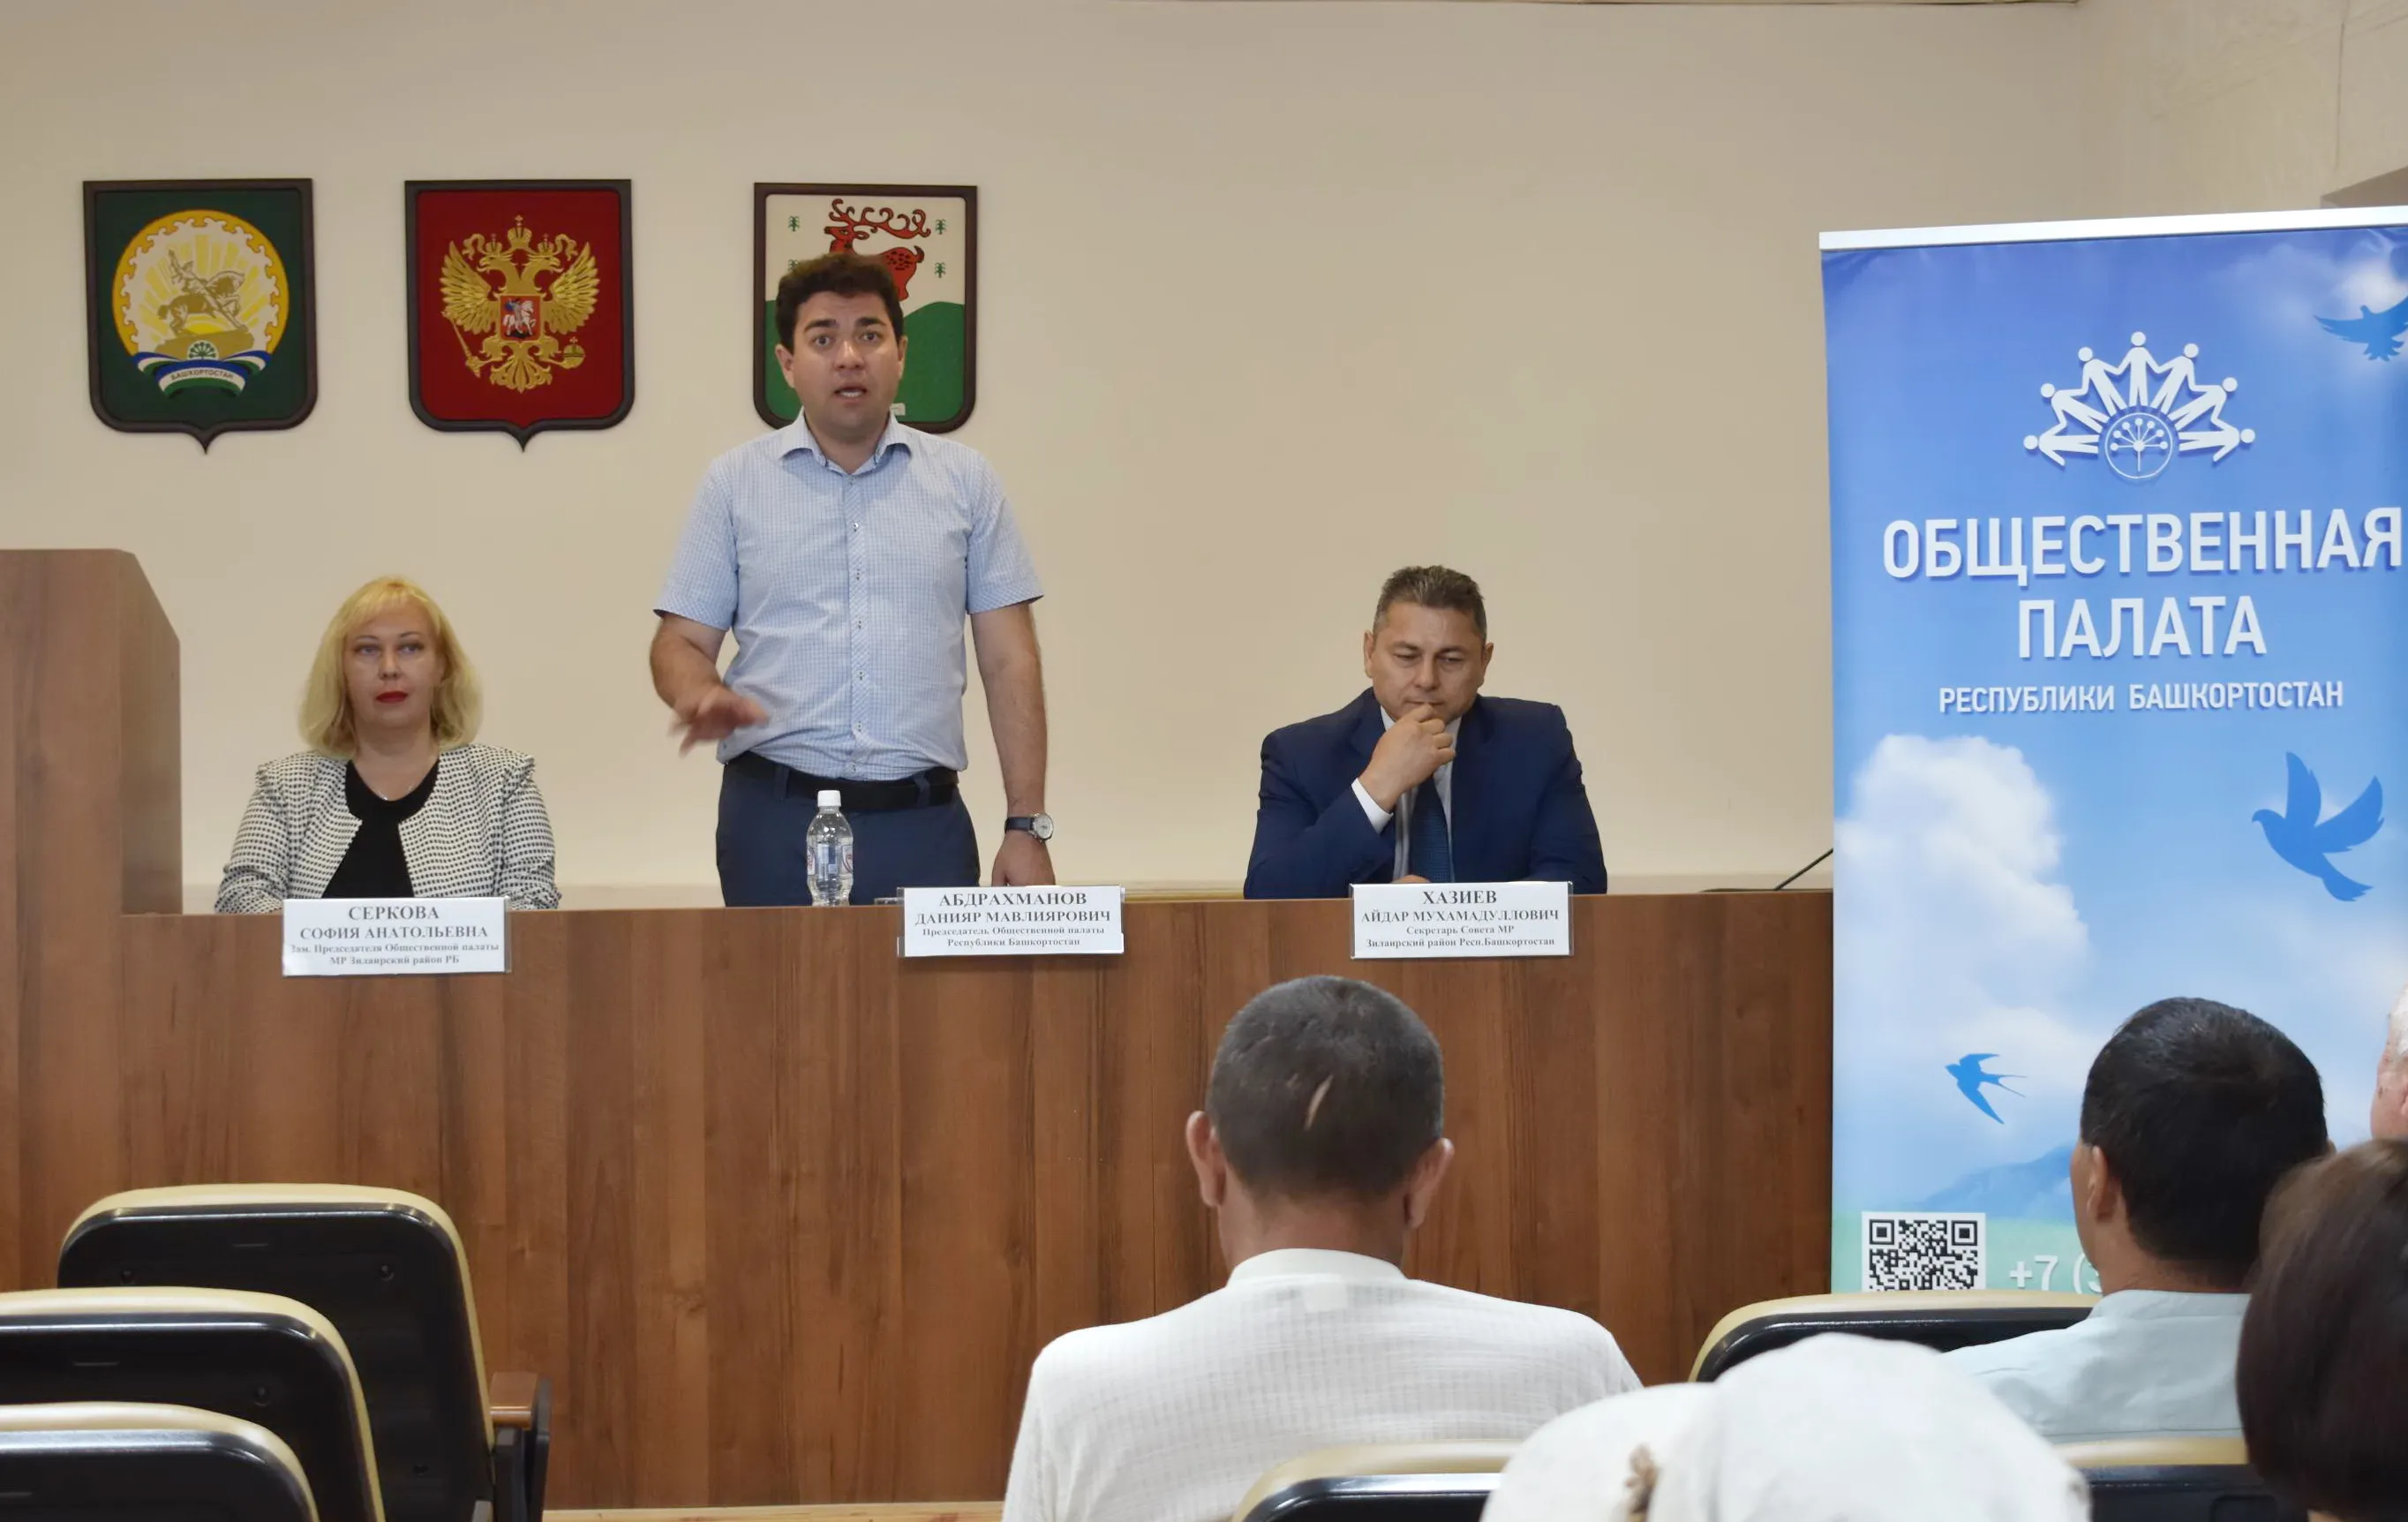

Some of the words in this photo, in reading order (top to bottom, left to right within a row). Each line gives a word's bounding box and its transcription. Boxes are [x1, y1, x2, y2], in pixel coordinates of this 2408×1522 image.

[171, 369, 234, 380] БАШКОРТОСТАН
[1883, 507, 2403, 587] ОБЩЕСТВЕННАЯ
[2018, 595, 2268, 659] ПАЛАТА
[1938, 685, 2115, 713] РЕСПУБЛИКИ
[2129, 681, 2344, 710] БАШКОРТОСТАН
[939, 893, 1087, 907] АБДРАХМАНОВ
[1422, 890, 1498, 905] ХАЗИЕВ
[349, 906, 440, 920] СЕРКОВА
[914, 912, 982, 925] ДАНИЯР
[986, 910, 1110, 923] МАВЛИЯРОВИЧ
[1361, 909, 1409, 923] АЙДАР
[1413, 909, 1560, 922] МУХАМАДУЛЛОВИЧ
[300, 927, 360, 939] СОФИЯ
[365, 925, 488, 938] АНАТОЛЬЕВНА
[922, 928, 990, 937] Председатель
[992, 926, 1065, 936] Общественной
[1406, 926, 1458, 935] Секретарь
[1461, 925, 1495, 934] Совета
[314, 944, 382, 954] Председателя
[385, 943, 459, 953] Общественной
[947, 938, 1005, 948] Республики
[1009, 937, 1080, 947] Башкортостан
[1366, 938, 1425, 948] Зилаирский
[1427, 938, 1456, 948] район
[413, 956, 442, 965] район
[2009, 1255, 2059, 1291] +7
